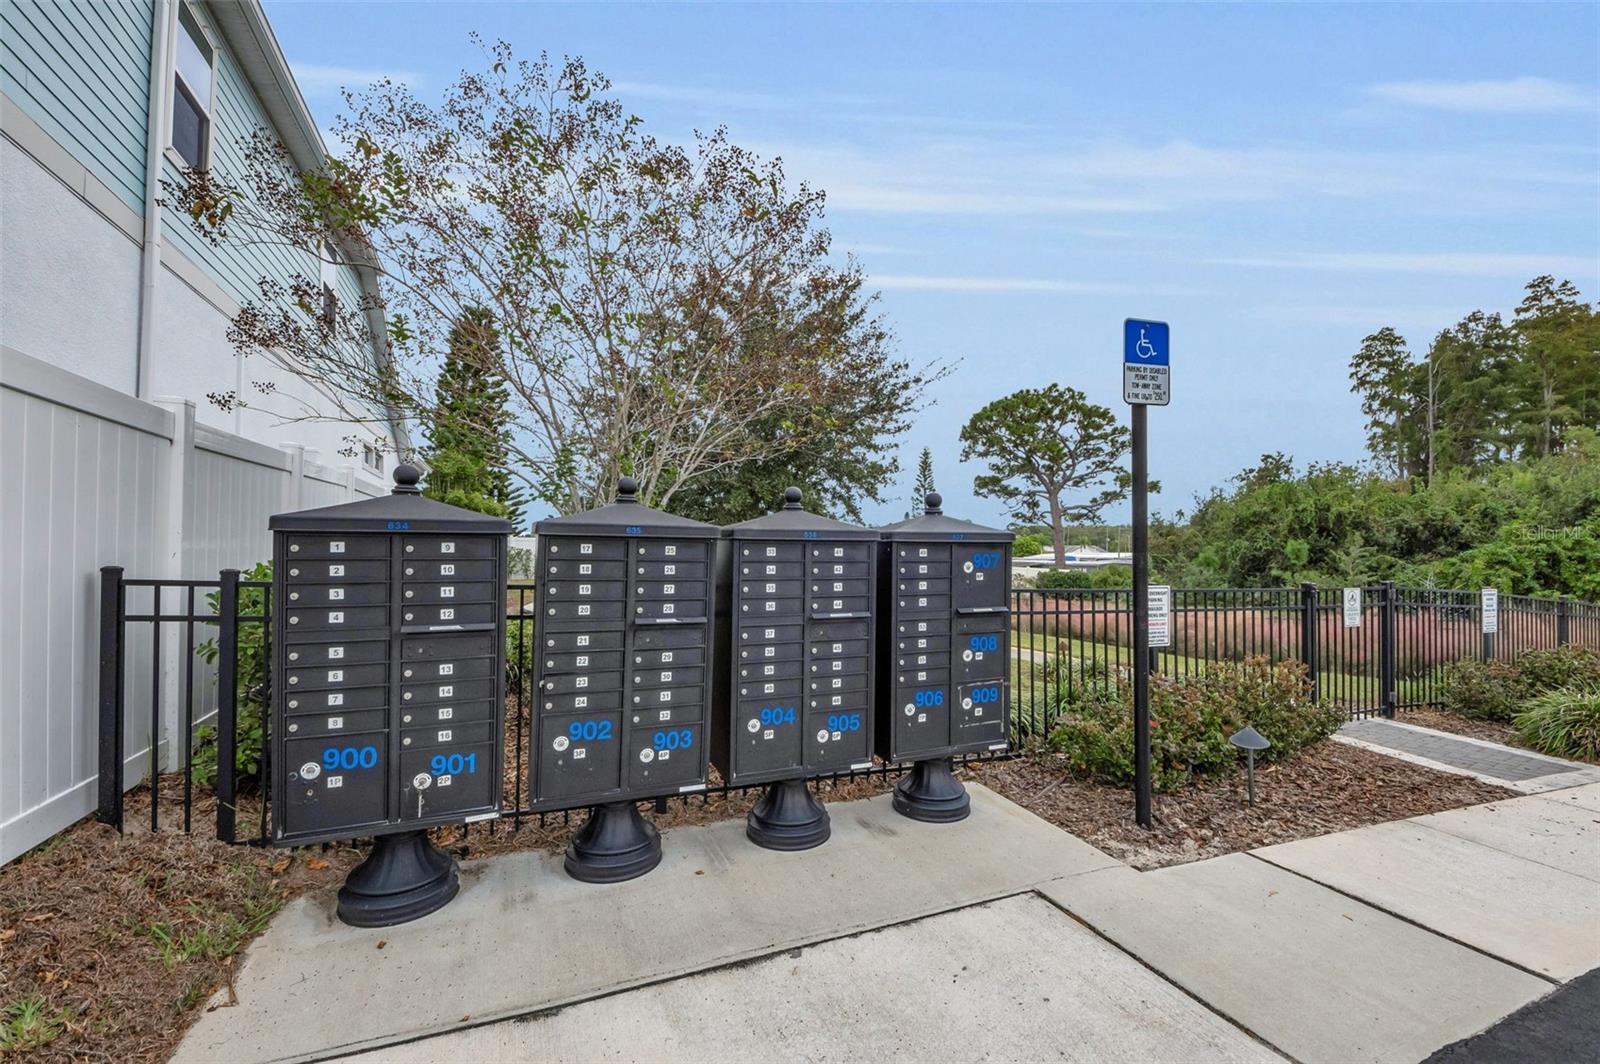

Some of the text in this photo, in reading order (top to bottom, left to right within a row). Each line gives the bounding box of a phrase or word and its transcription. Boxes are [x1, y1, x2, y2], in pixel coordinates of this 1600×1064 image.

[387, 522, 408, 530] 634
[974, 552, 1000, 568] 907
[970, 636, 998, 651] 908
[915, 690, 944, 706] 906
[972, 688, 998, 704] 909
[760, 706, 796, 726] 904
[828, 714, 860, 732] 905
[569, 720, 612, 741] 902
[654, 730, 692, 751] 903
[322, 746, 378, 770] 900
[430, 752, 476, 776] 901
